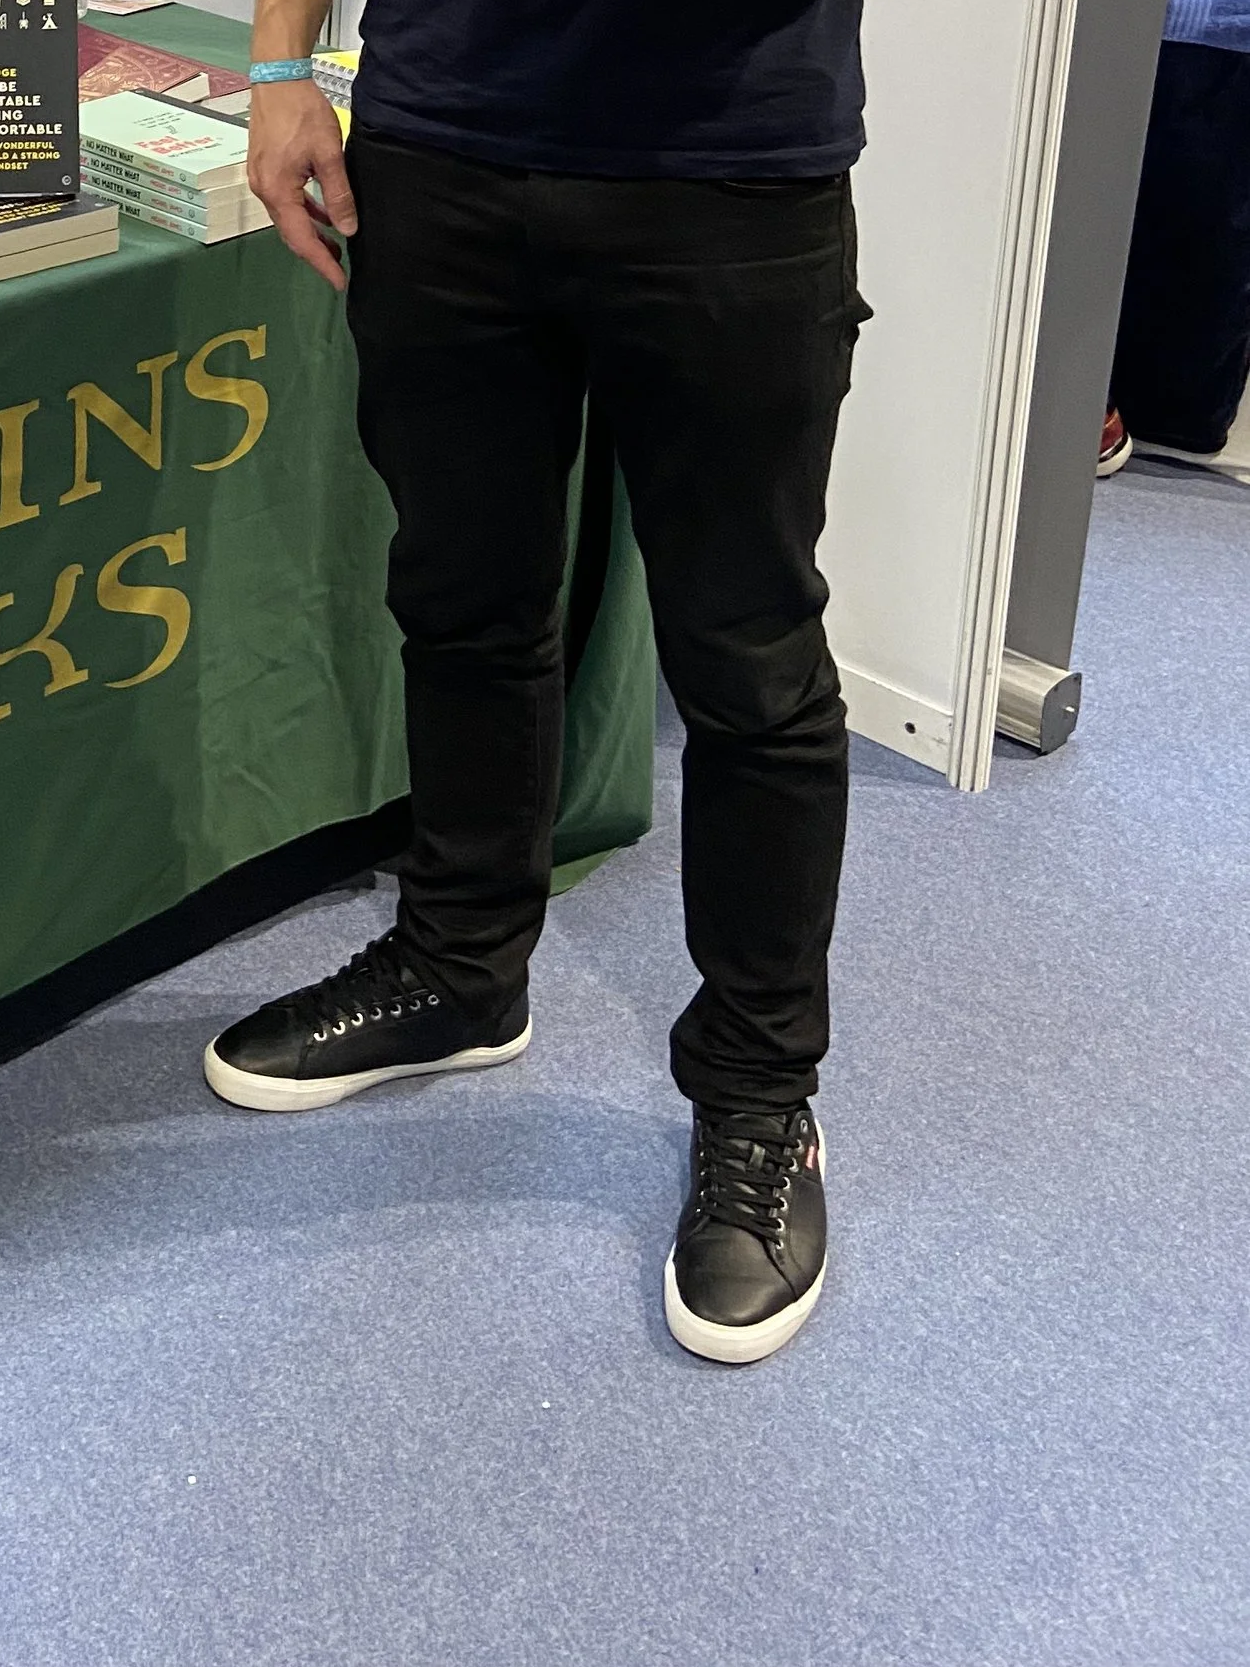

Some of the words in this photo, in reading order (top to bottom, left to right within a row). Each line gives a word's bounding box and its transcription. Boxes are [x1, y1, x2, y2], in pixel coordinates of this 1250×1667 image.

[0, 81, 17, 92] BE
[135, 135, 178, 148] Feel
[152, 136, 214, 154] Better
[11, 152, 19, 160] A
[21, 151, 60, 160] STRONG
[86, 139, 95, 149] NO
[96, 142, 117, 157] MATTER
[118, 150, 134, 163] WHAT
[90, 158, 99, 168] NO
[101, 161, 123, 176] MATTER
[124, 169, 140, 182] WHAT
[92, 176, 100, 185] NO
[102, 179, 124, 194] MATTER
[125, 186, 141, 199] WHAT
[125, 204, 140, 217] WHAT
